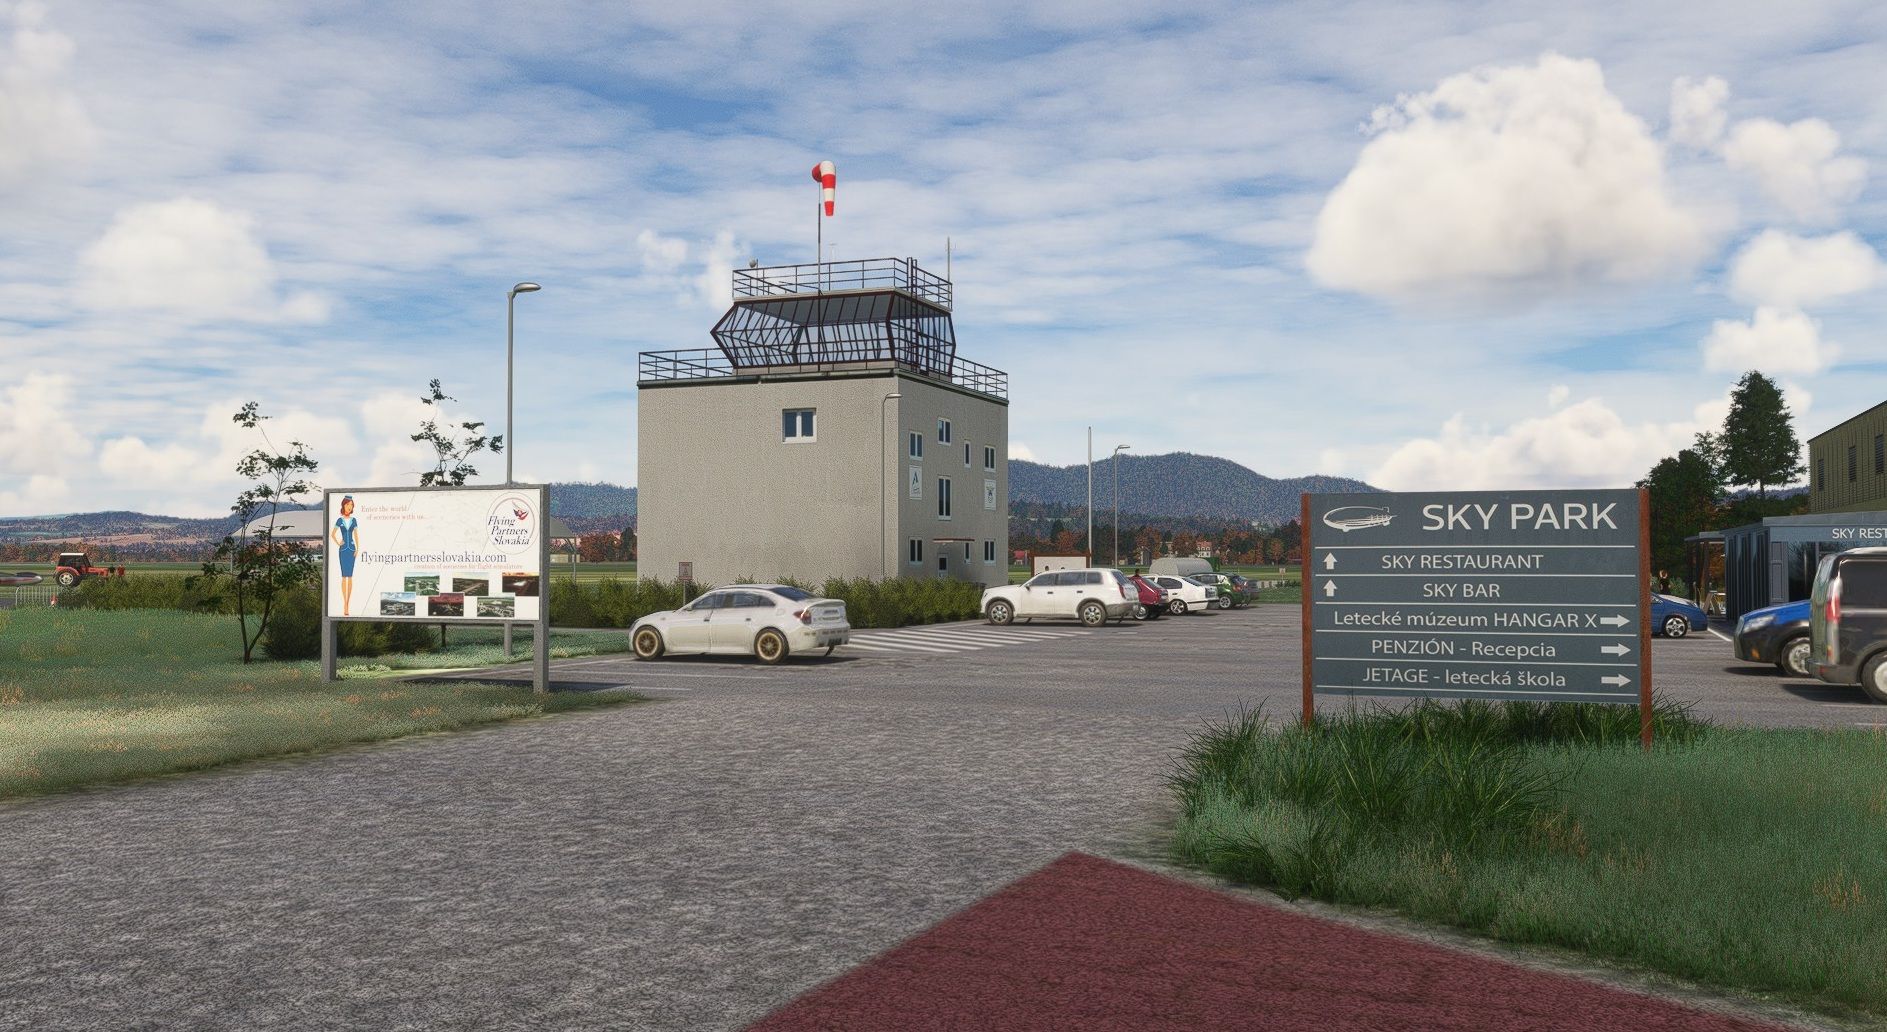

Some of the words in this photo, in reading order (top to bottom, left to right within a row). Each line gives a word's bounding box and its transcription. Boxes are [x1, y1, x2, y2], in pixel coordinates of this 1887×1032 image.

[488, 516, 516, 527] Flying
[1422, 503, 1498, 531] SKY
[1511, 502, 1618, 530] PARK
[491, 526, 528, 535] Partners
[1832, 528, 1855, 539] SKY
[494, 536, 530, 545] Slovakia
[361, 551, 507, 564] flyingpartnersslovakia.com
[1381, 555, 1416, 569] SKY
[1420, 554, 1544, 569] RESTAURANT
[1423, 583, 1458, 598] SKY
[1463, 583, 1500, 598] BAR
[1334, 610, 1401, 627] Letecké
[1407, 611, 1488, 627] múzeum
[1494, 613, 1579, 628] HANGAR
[1584, 613, 1597, 628] X
[1372, 637, 1455, 655] PENZIÓN
[1472, 641, 1556, 659] Recepcia
[1363, 668, 1428, 683] JETAGE
[1445, 669, 1512, 685] letecká
[1517, 670, 1566, 687] škola
